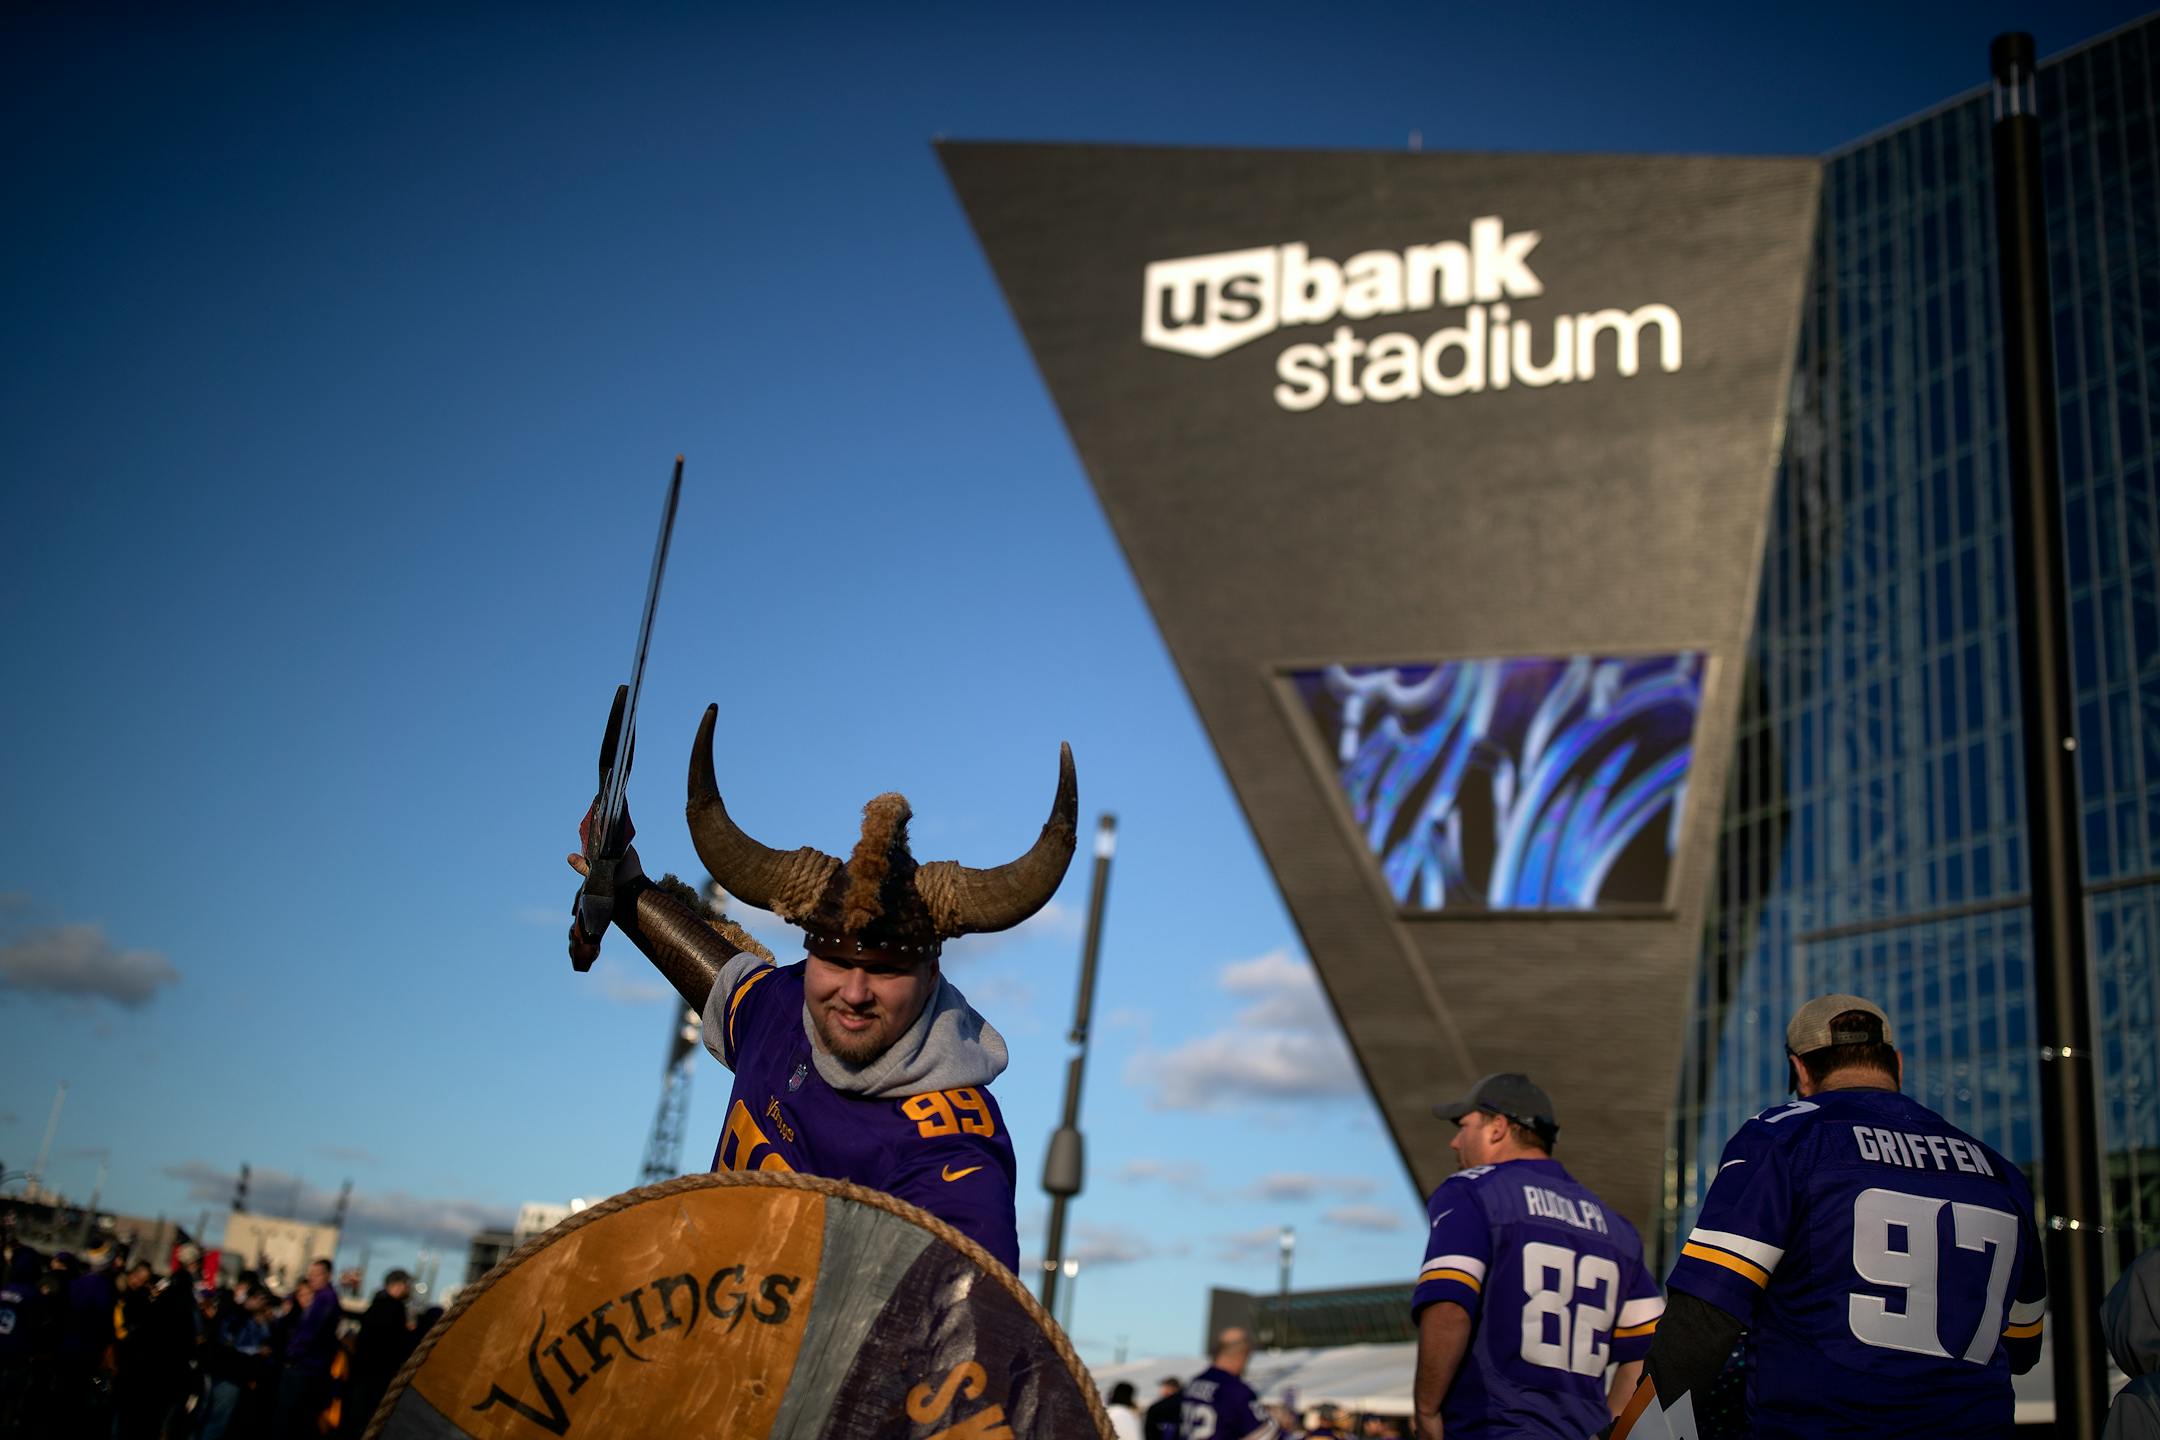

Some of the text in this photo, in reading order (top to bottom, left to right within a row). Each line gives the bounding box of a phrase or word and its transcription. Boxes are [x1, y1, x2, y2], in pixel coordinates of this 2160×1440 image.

[1278, 215, 1544, 326] bank
[1273, 302, 1683, 411] stadium
[902, 1087, 995, 1138] 99
[1853, 1125, 1994, 1177] GRIFFEN
[1523, 1185, 1609, 1235] RUDOLPH
[1521, 1242, 1620, 1378] 82
[1849, 1188, 2018, 1366] 97
